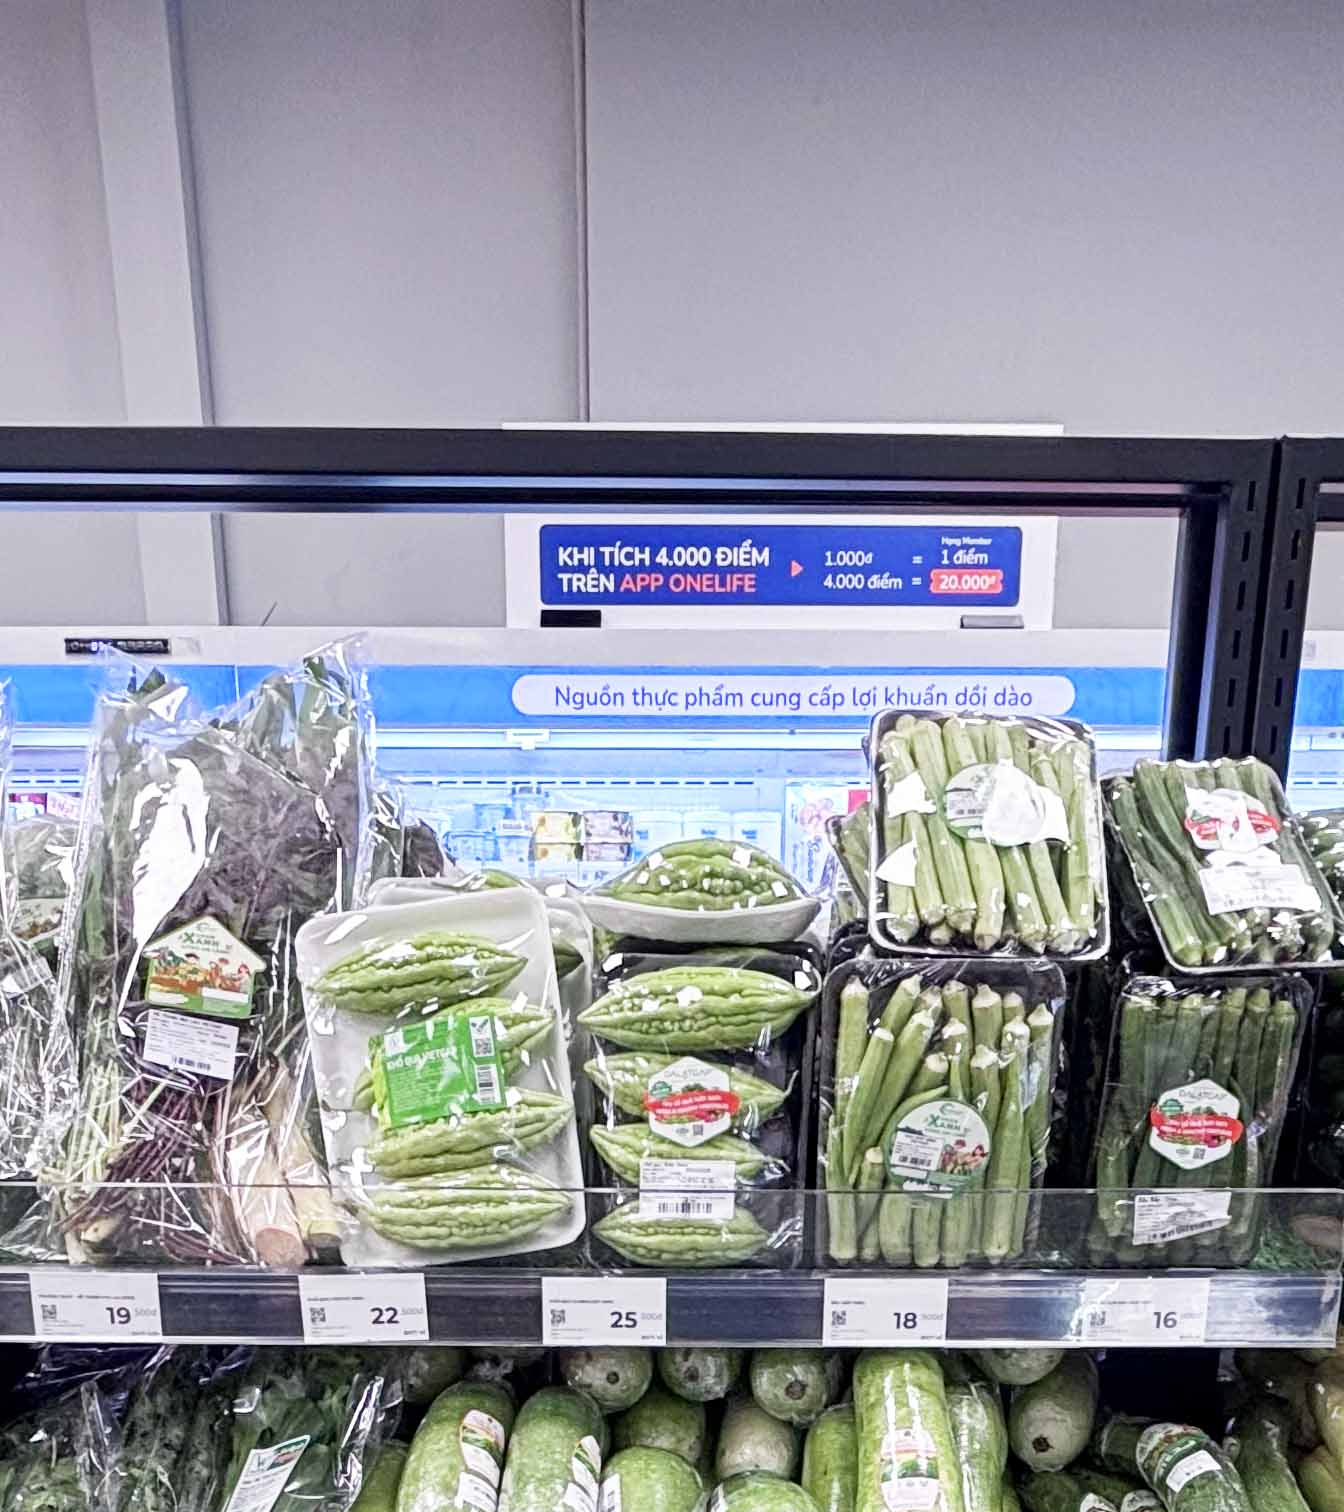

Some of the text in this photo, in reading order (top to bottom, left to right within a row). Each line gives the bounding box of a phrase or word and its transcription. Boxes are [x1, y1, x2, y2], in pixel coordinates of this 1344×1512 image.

[558, 539, 770, 566] KHI TÍCH 4.000 ĐIỂM
[941, 549, 949, 565] 1
[953, 547, 989, 565] điểm
[557, 567, 757, 593] TRÊN APP ONELIFE
[823, 573, 865, 590] 4.000
[867, 571, 903, 590] điểm
[555, 683, 1033, 712] Nguồn thực phẩm cung cấp lợi khuẩn dồi dào
[105, 1306, 131, 1325] 19
[370, 1306, 399, 1325] 22
[610, 1311, 638, 1329] 25
[893, 1312, 917, 1330] 18
[1153, 1311, 1177, 1329] 16
